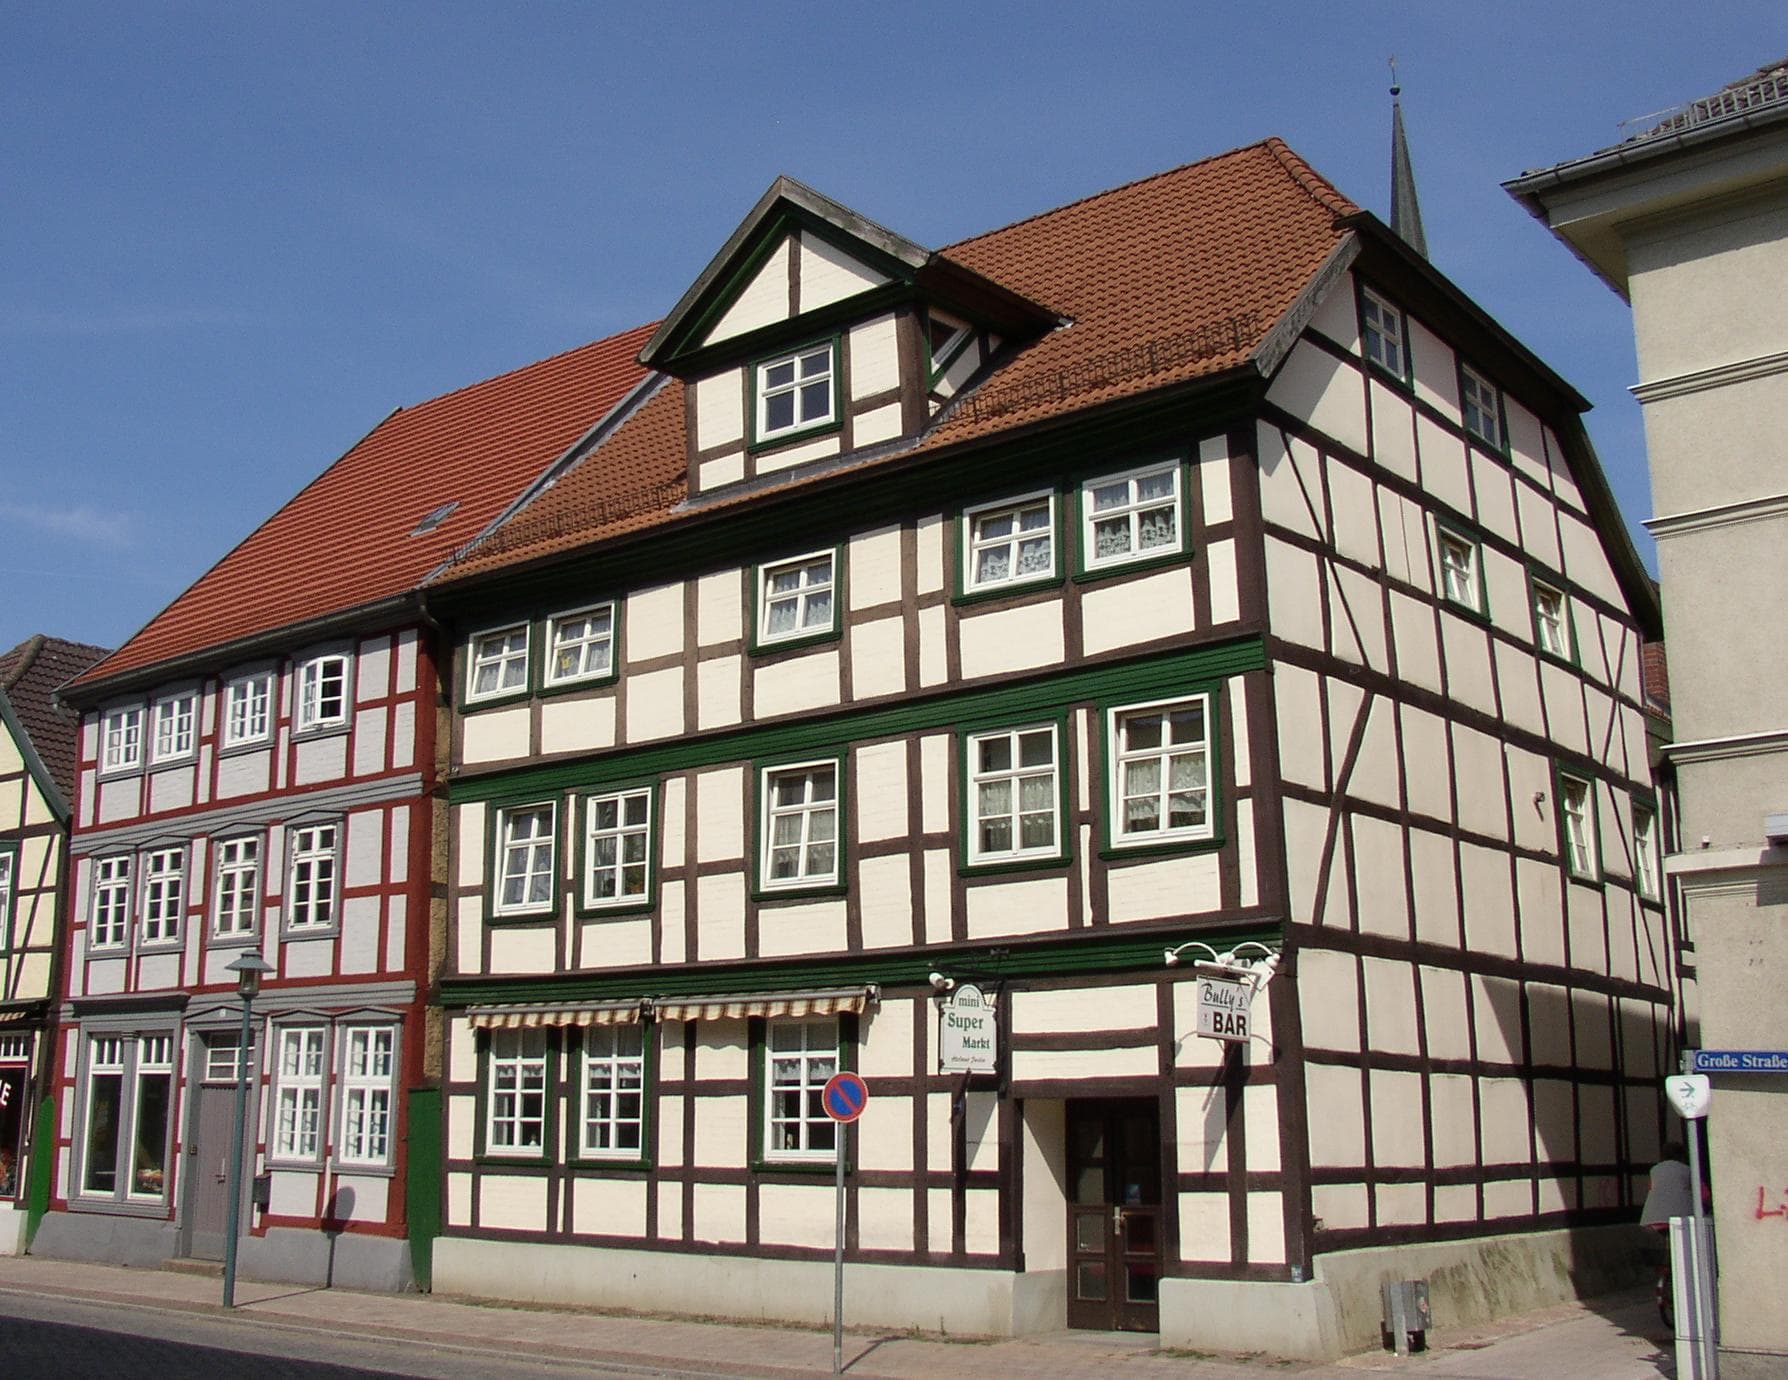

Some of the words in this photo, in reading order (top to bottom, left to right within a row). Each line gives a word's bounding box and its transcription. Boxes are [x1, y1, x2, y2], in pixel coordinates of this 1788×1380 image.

[959, 995, 980, 1008] mini
[948, 1012, 984, 1031] Super
[1213, 1011, 1247, 1036] BAR
[962, 1036, 990, 1049] Markt
[1697, 1053, 1739, 1068] Große
[1742, 1053, 1788, 1069] Straße
